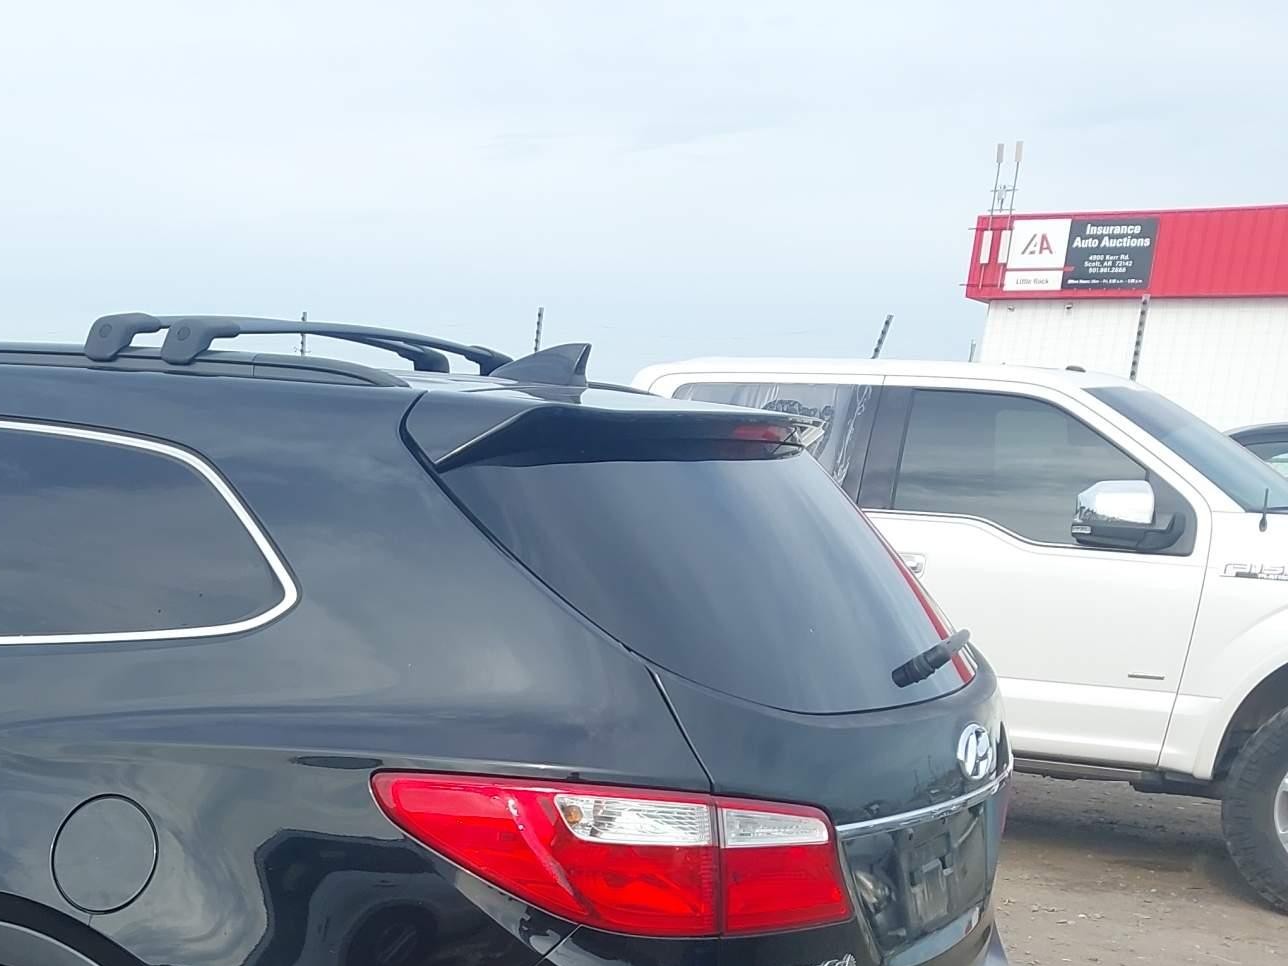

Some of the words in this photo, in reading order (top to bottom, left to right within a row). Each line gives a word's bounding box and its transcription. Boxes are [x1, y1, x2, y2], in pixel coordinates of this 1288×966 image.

[1086, 223, 1142, 235] Insurance
[1072, 236, 1099, 248] Auto
[1100, 235, 1151, 247] Auctions
